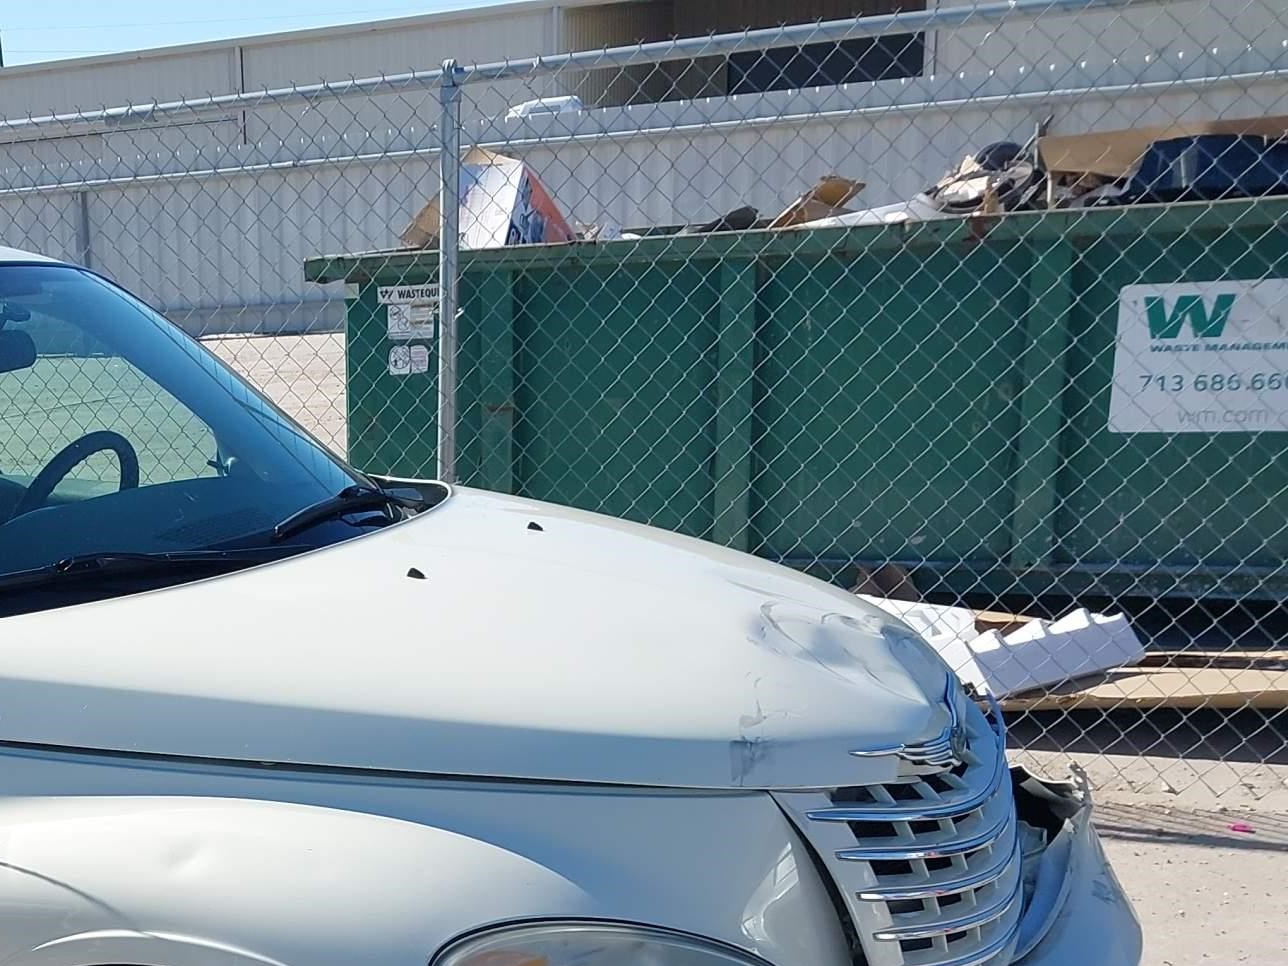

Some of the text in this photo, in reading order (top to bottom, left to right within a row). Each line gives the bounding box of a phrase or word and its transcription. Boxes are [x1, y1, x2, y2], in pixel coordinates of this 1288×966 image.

[1204, 341, 1288, 352] MANAGEM
[1139, 372, 1288, 393] 713 686.66
[1177, 408, 1269, 425] wm.com
